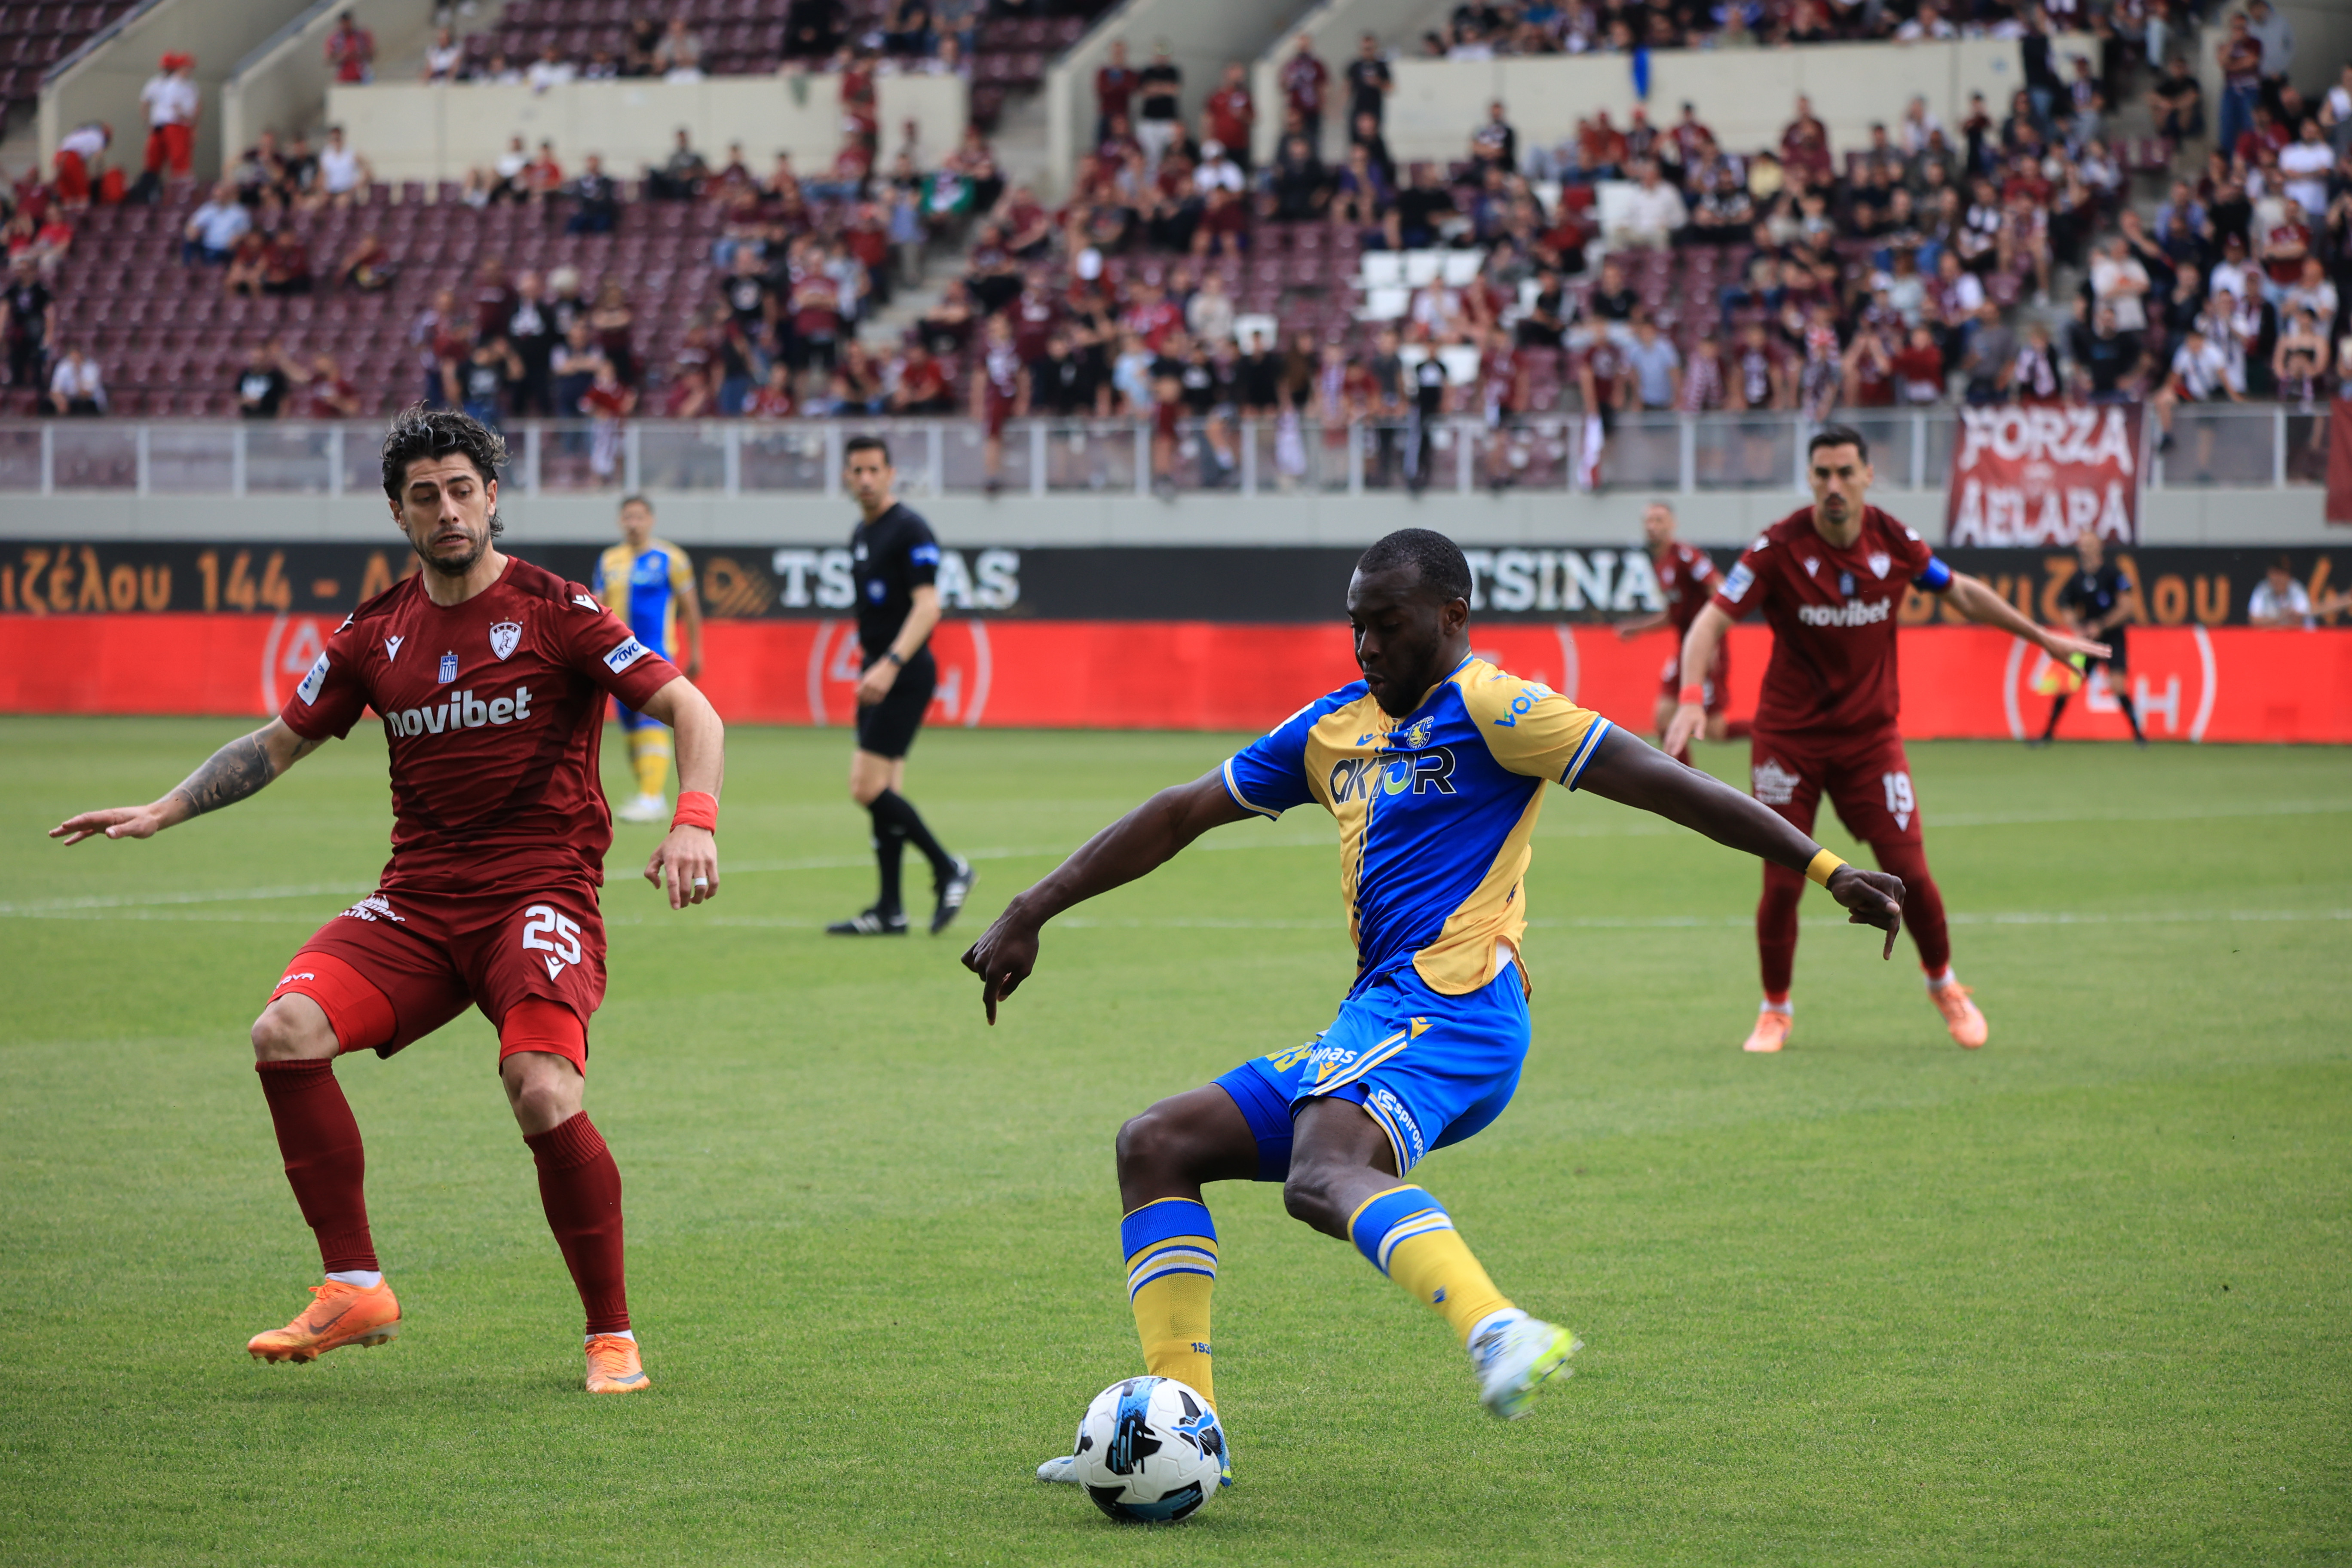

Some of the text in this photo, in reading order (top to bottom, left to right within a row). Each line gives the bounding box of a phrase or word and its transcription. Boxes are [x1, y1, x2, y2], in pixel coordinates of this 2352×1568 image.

[1958, 405, 2135, 476] FORZA
[197, 550, 291, 613] 144
[772, 548, 1020, 610] TSAS
[1798, 597, 1891, 628] novibet
[386, 686, 532, 738] novibet
[1882, 772, 1916, 813] 19
[522, 905, 582, 965] 25
